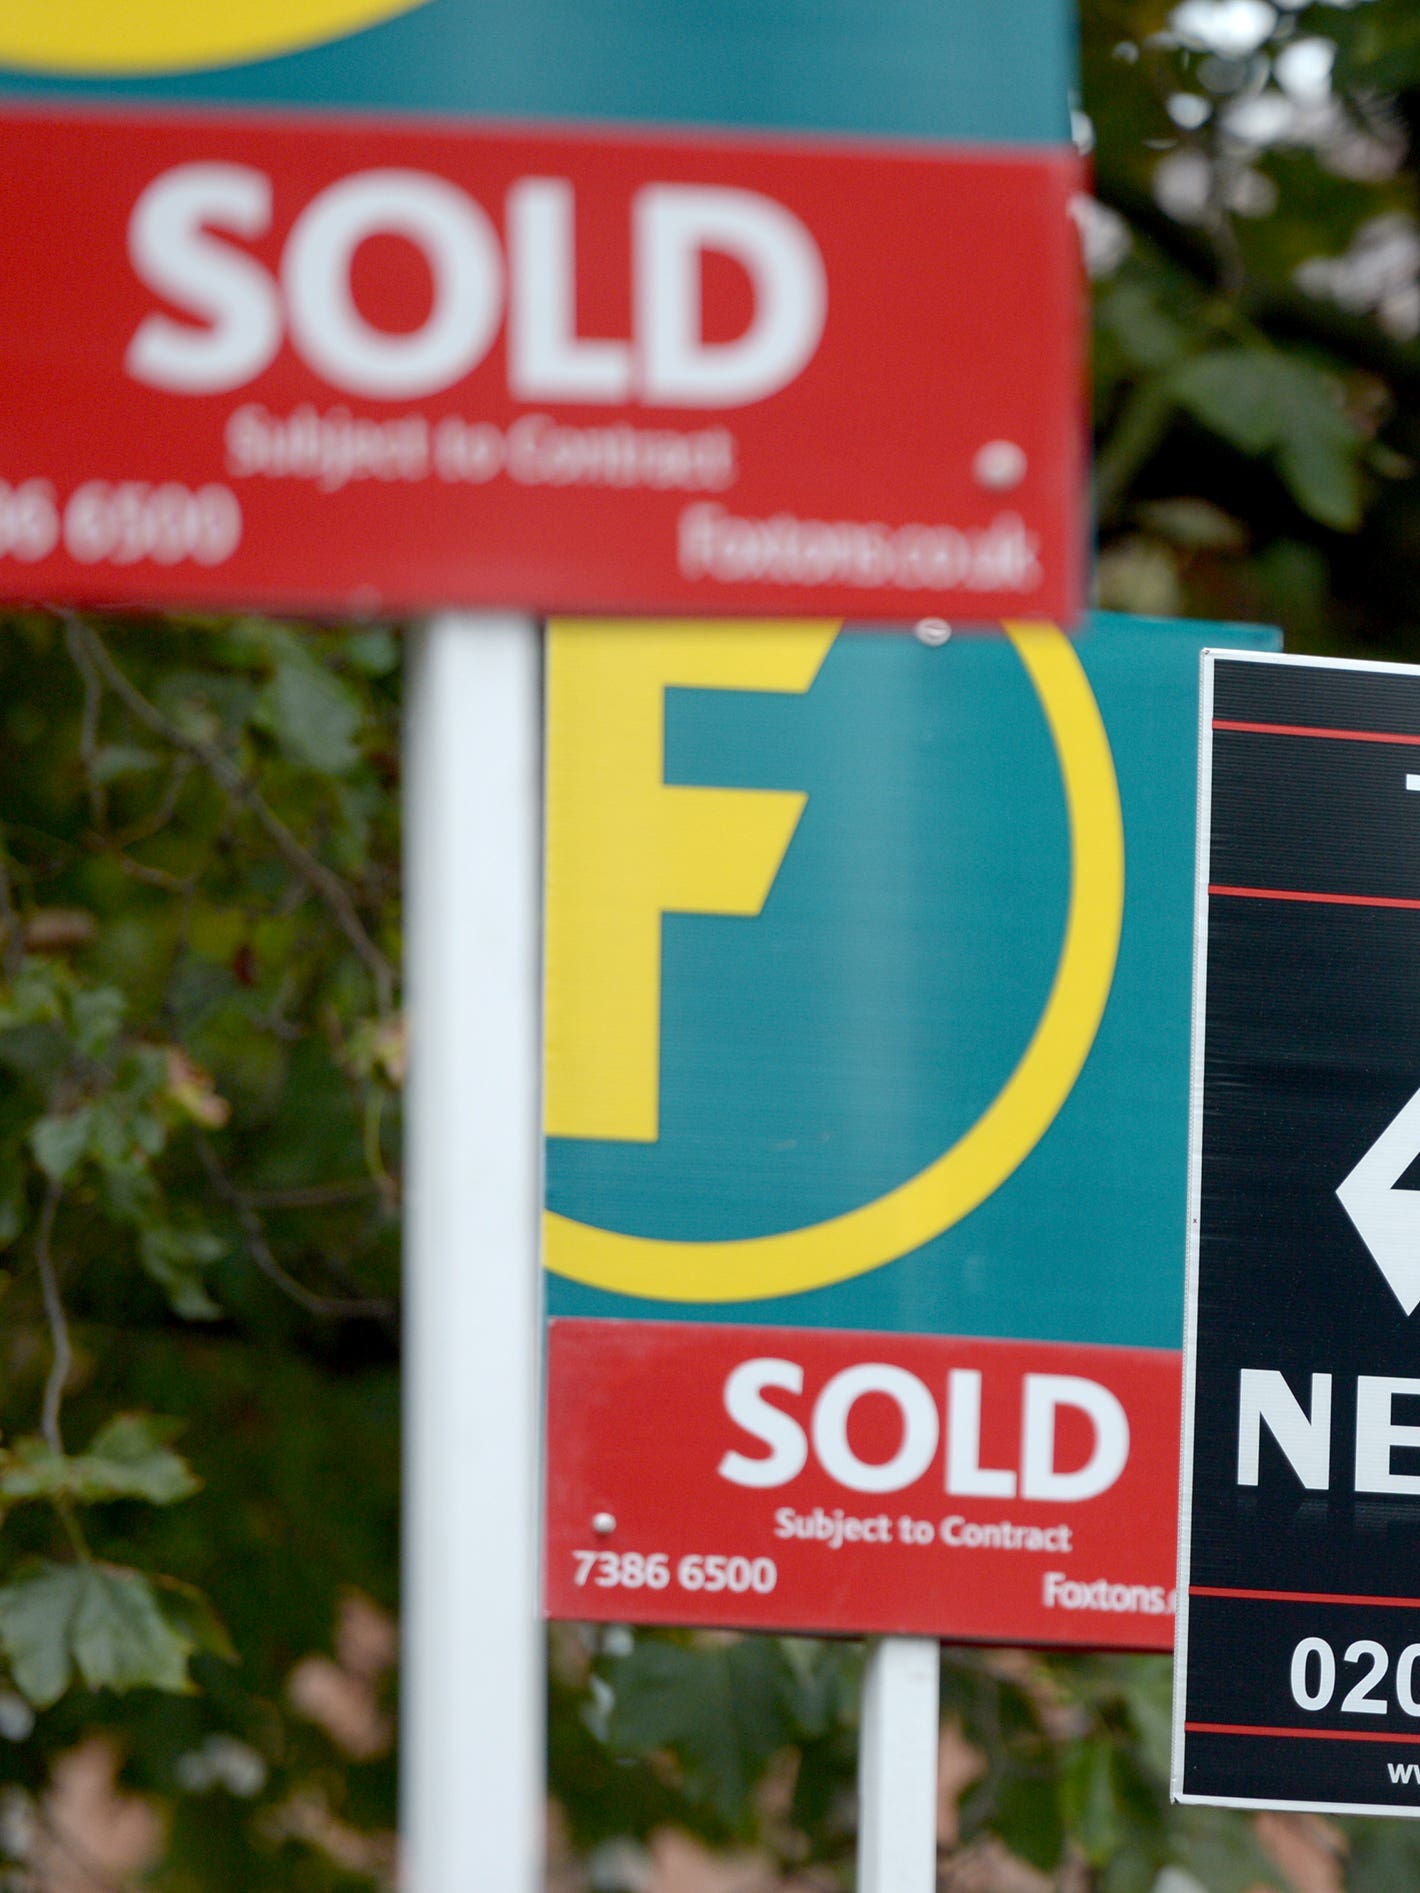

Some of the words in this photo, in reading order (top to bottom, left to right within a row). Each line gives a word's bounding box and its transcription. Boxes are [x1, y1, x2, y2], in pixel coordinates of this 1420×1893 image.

[128, 163, 827, 408] SOLD
[226, 404, 429, 492] Subject
[434, 416, 504, 483] to
[505, 413, 737, 490] Contract
[64, 480, 242, 565] 6500
[678, 503, 1040, 591] Foxtons.co.uk
[545, 619, 845, 1143] F
[718, 1358, 1130, 1502] SOLD
[572, 1550, 670, 1589] 7386
[677, 1554, 777, 1594] 6500
[775, 1507, 892, 1549] Subject
[898, 1515, 935, 1545] to
[939, 1515, 1072, 1553] Contract
